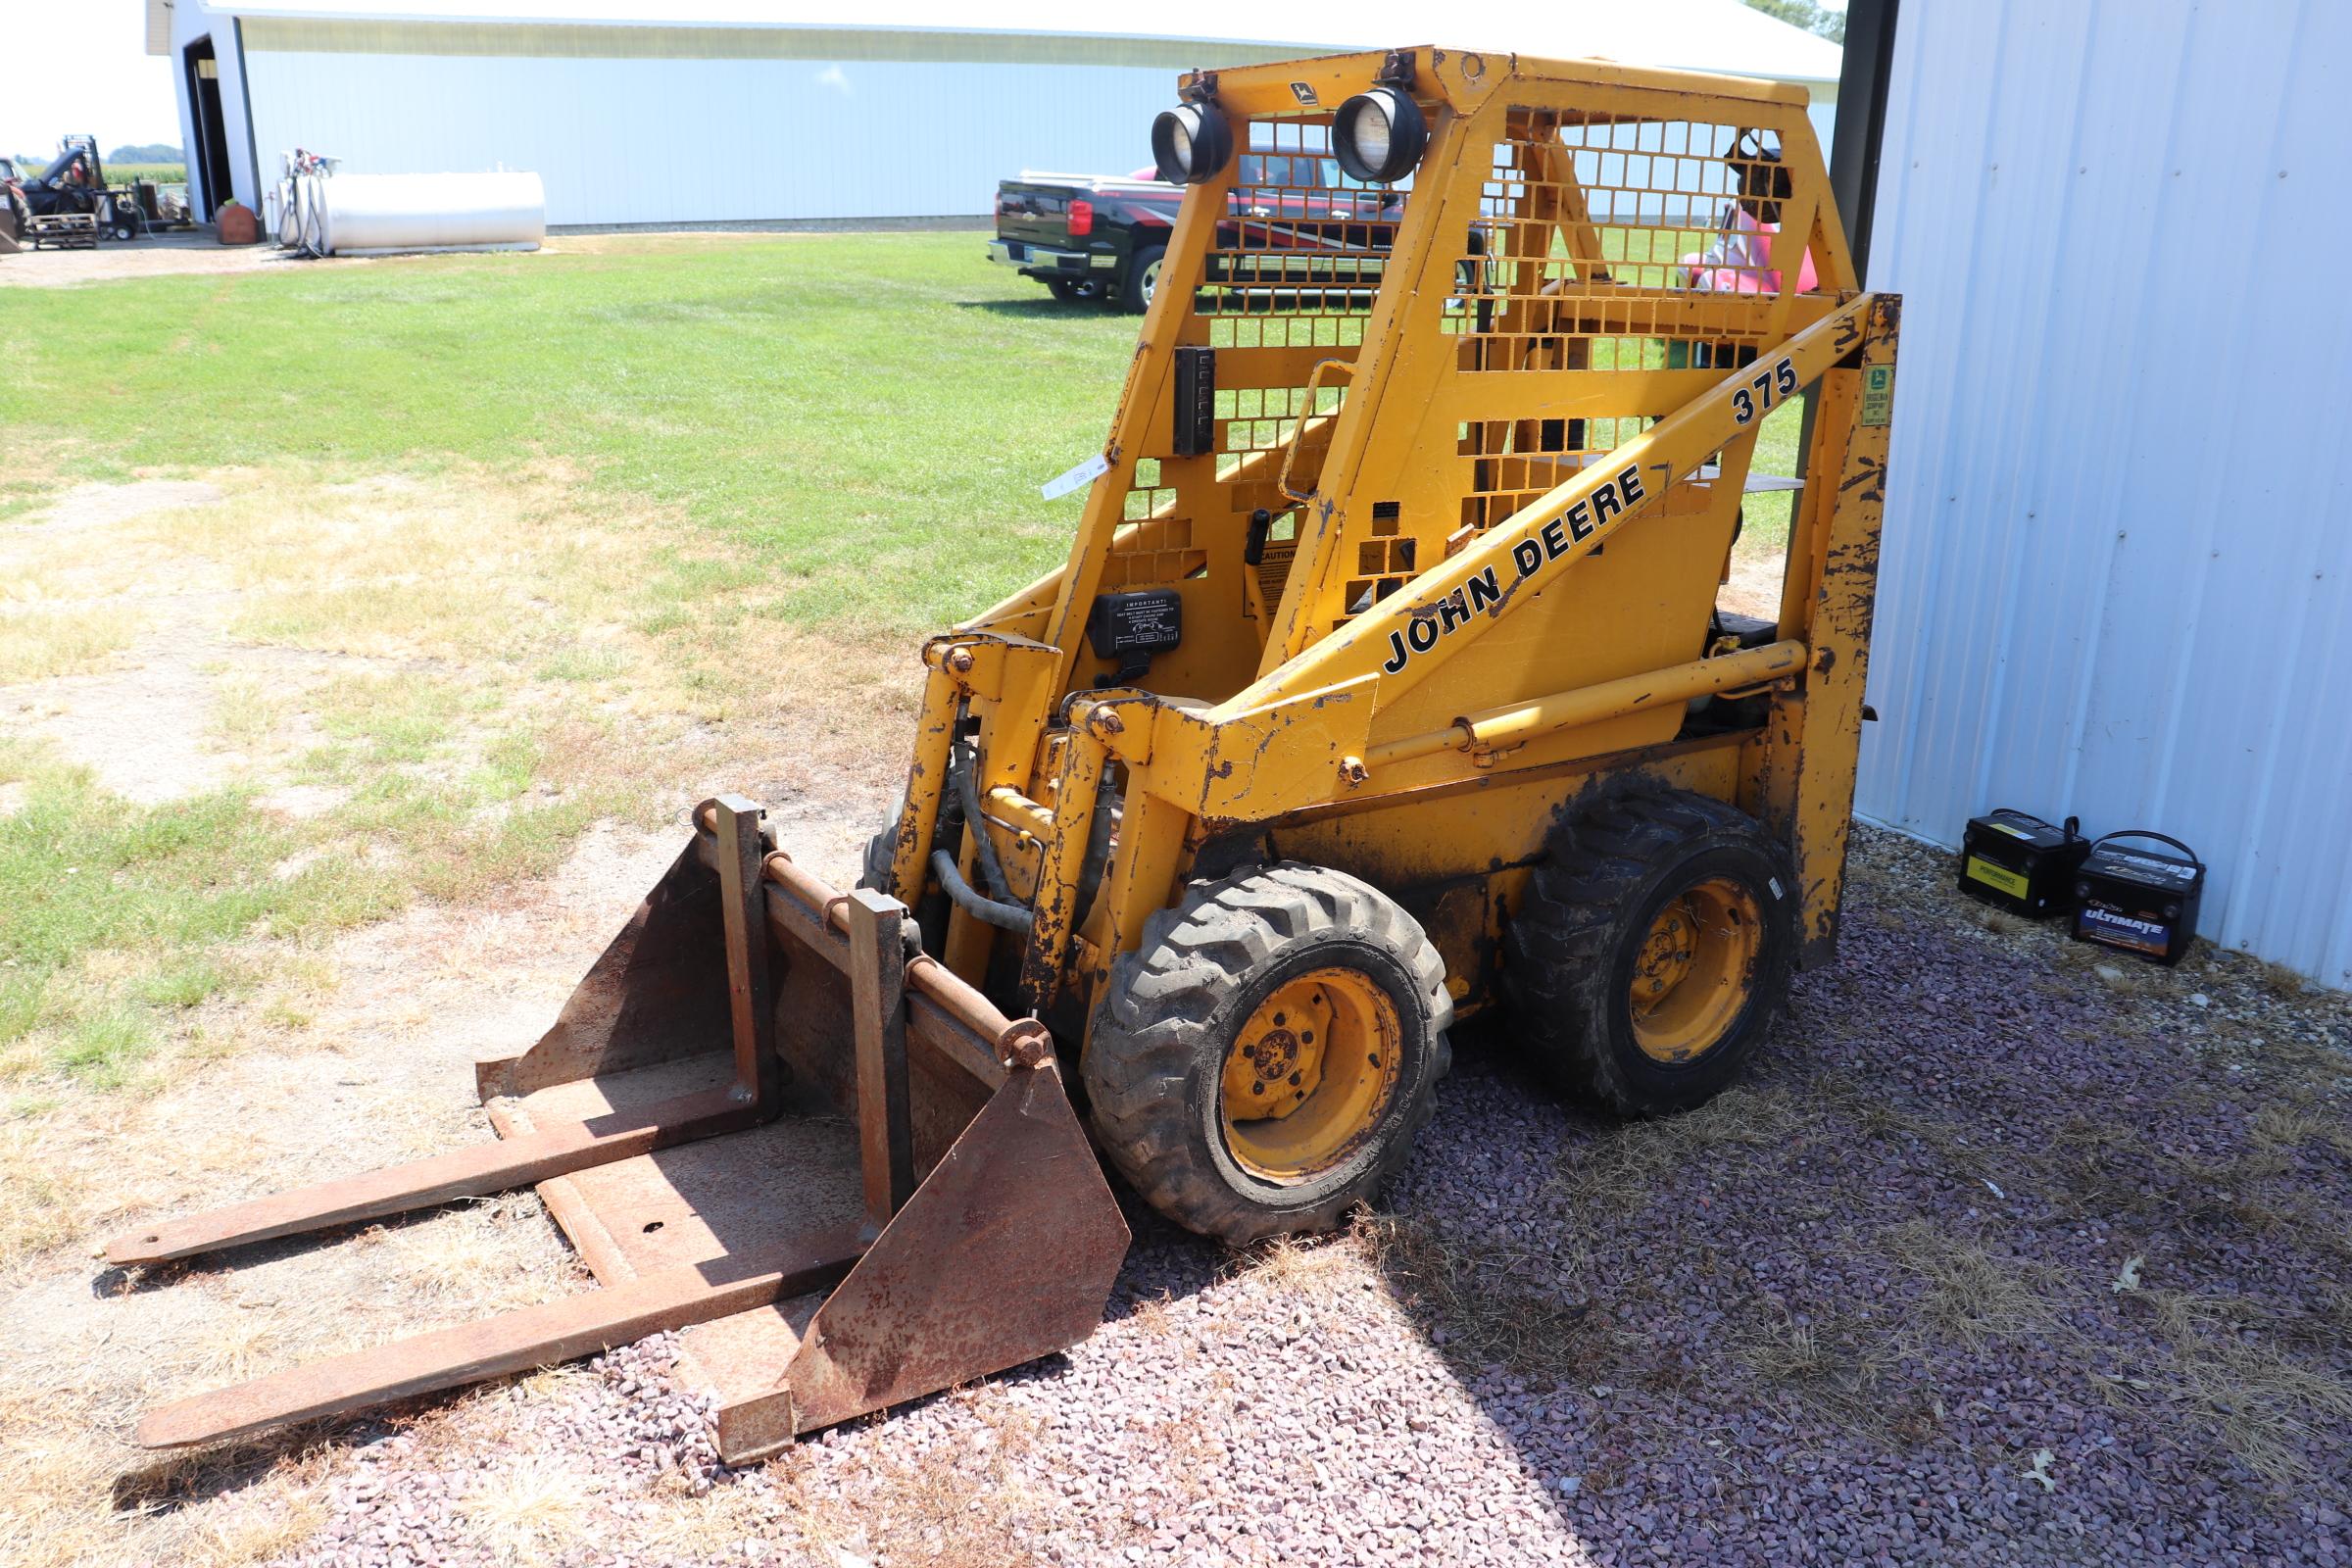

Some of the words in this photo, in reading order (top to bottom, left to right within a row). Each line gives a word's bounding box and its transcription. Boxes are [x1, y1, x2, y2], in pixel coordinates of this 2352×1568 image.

[1732, 356, 1797, 425] 375
[1383, 564, 1502, 675] JOHN
[1511, 463, 1646, 581] DEERE
[1126, 599, 1167, 608] IMPORTANT!
[2084, 909, 2164, 935] ULTIMATE
